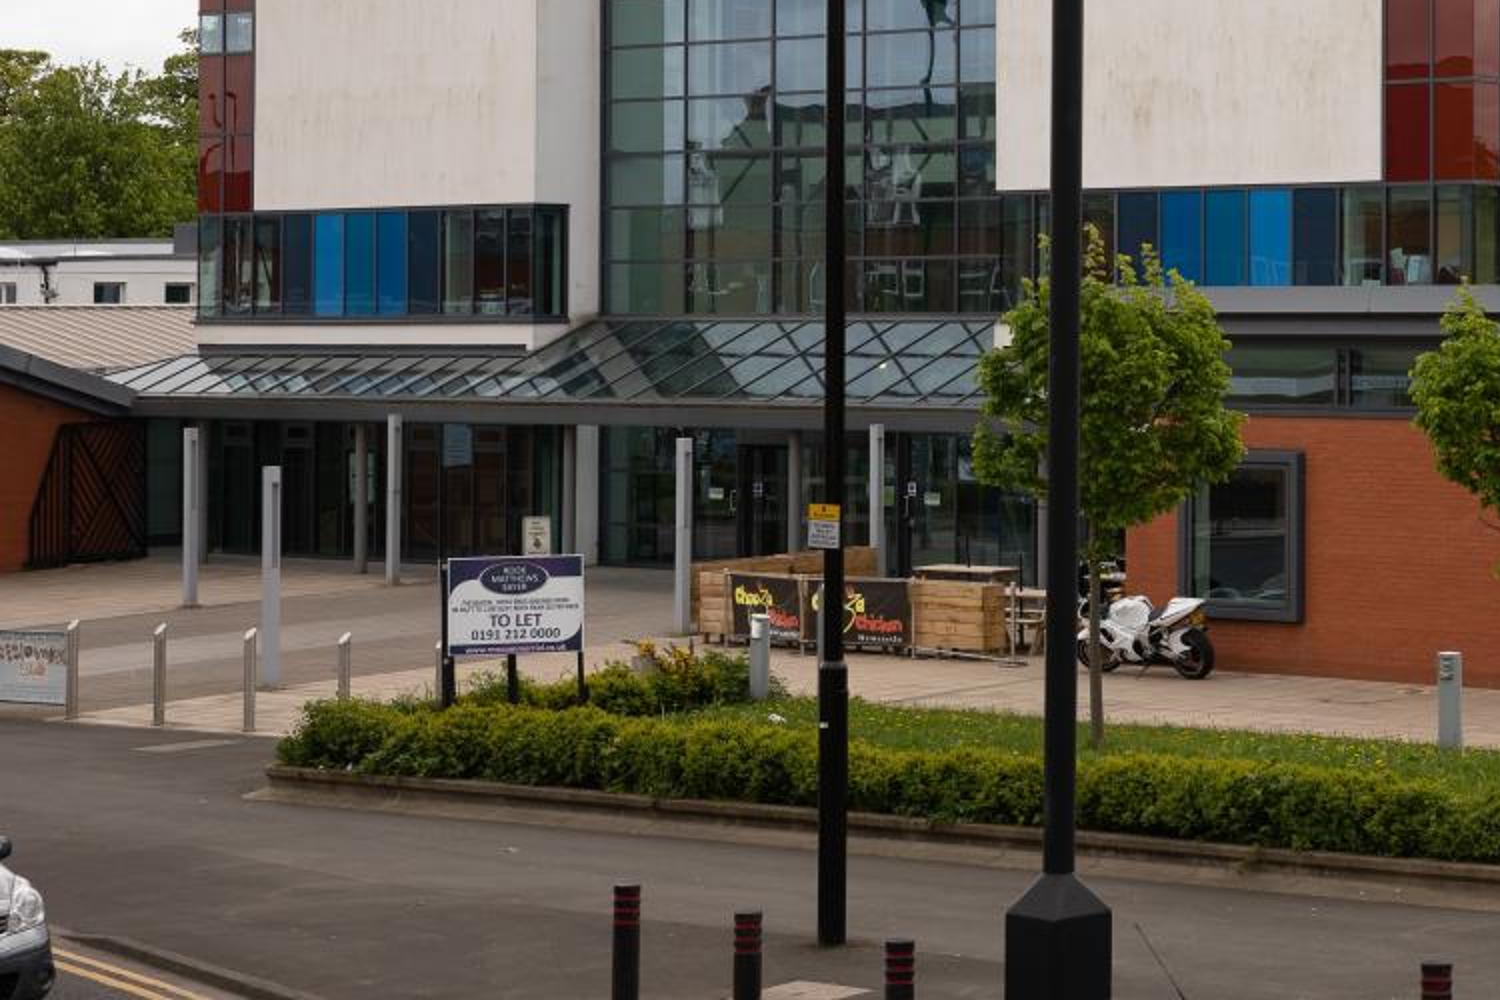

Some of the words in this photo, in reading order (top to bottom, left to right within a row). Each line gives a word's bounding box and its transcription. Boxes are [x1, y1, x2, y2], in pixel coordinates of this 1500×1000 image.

[490, 614, 510, 628] TO
[515, 613, 542, 627] LET
[471, 629, 501, 641] 0191
[504, 628, 527, 640] 212
[529, 627, 561, 639] 0000
